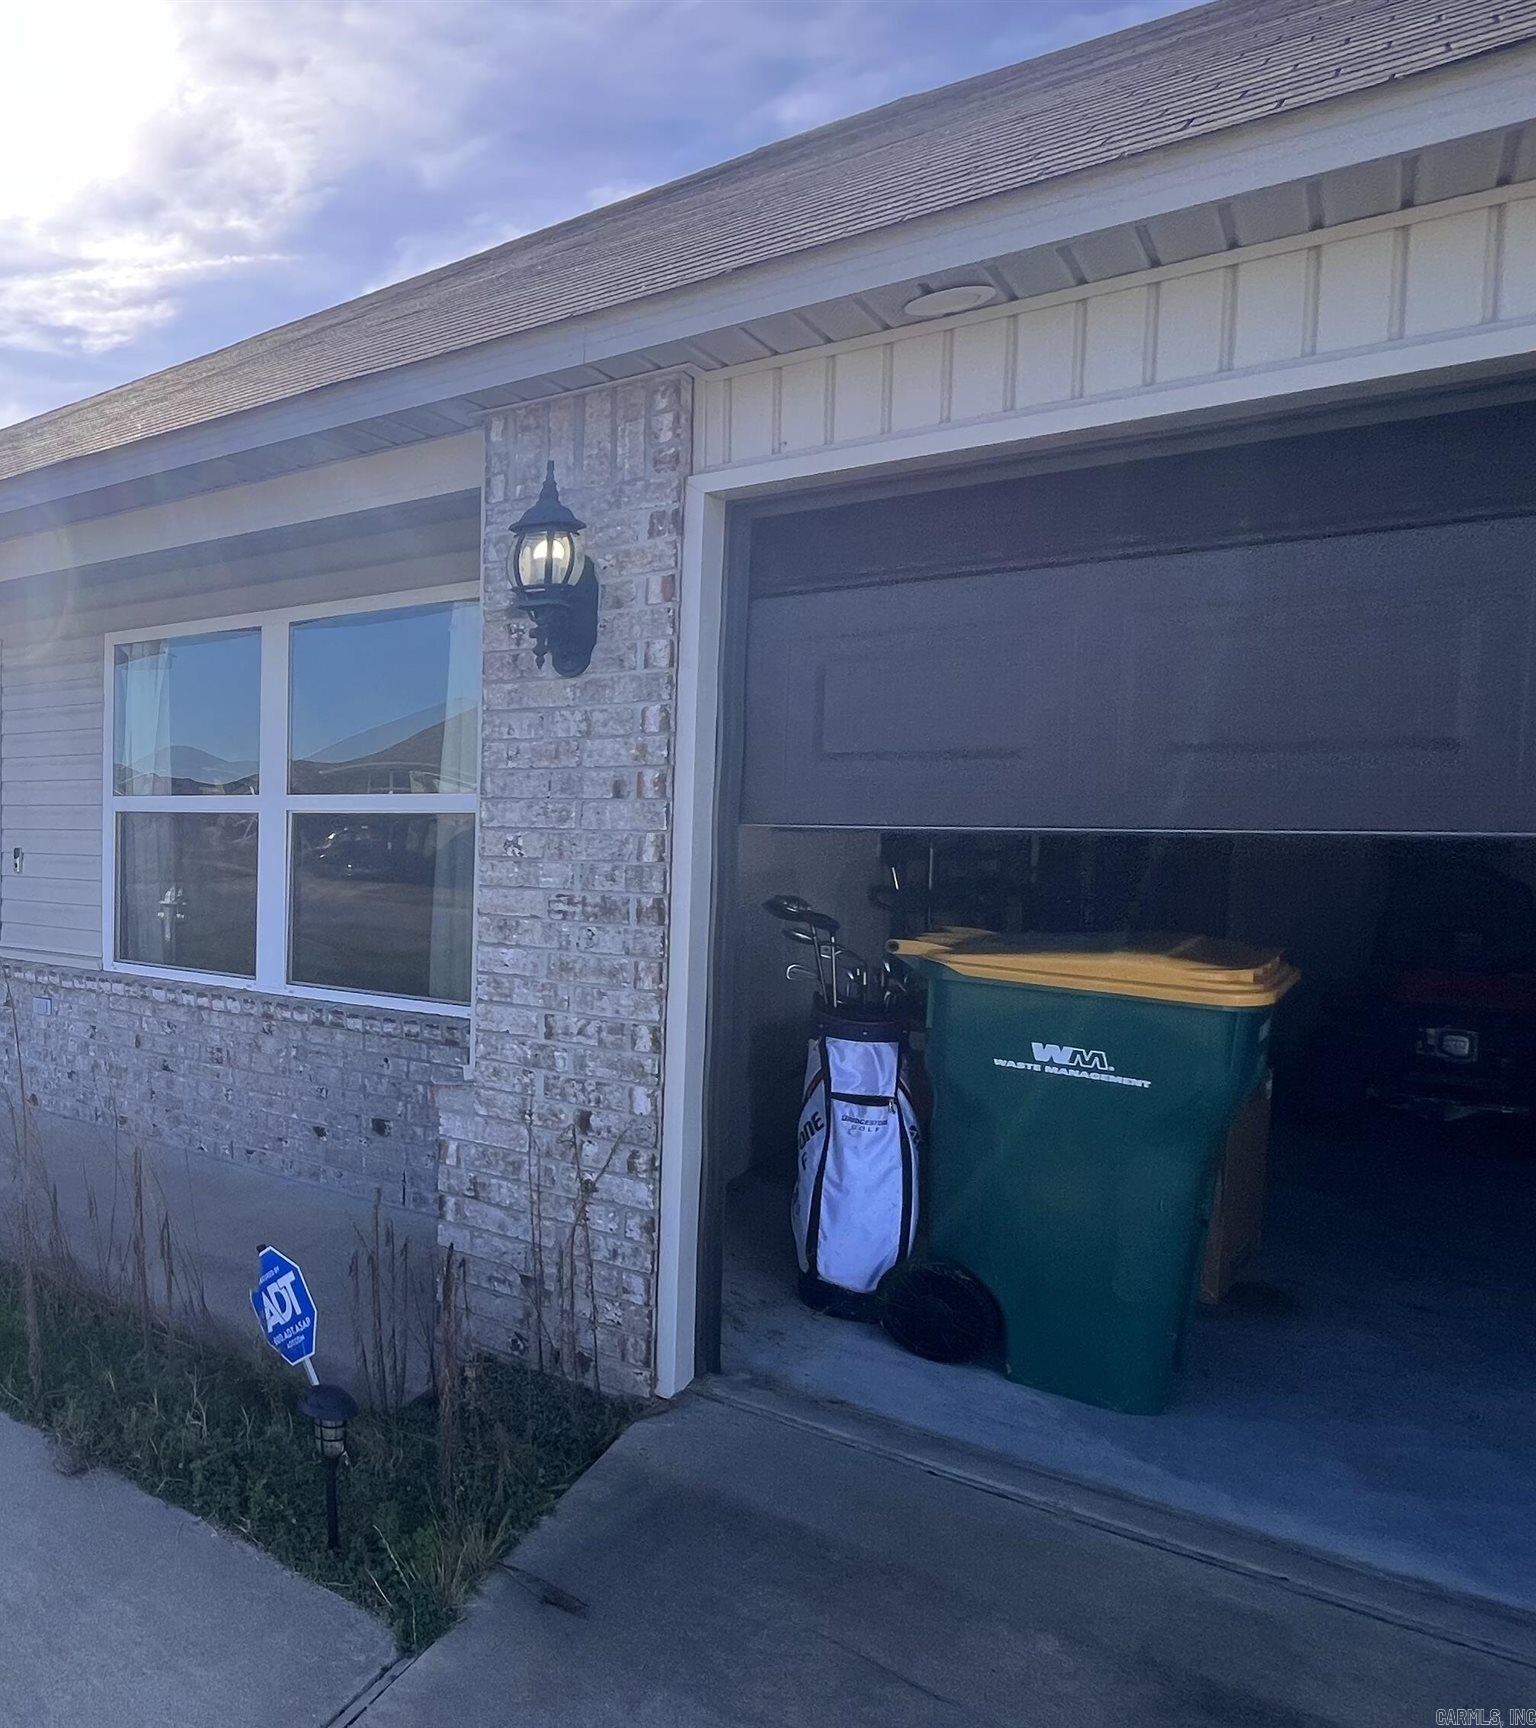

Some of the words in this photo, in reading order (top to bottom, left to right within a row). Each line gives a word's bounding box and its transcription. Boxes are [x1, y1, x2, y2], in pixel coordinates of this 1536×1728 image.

[993, 1058, 1041, 1072] WASTE
[1044, 1065, 1152, 1088] MANAGEMENT
[262, 1270, 302, 1333] ADT
